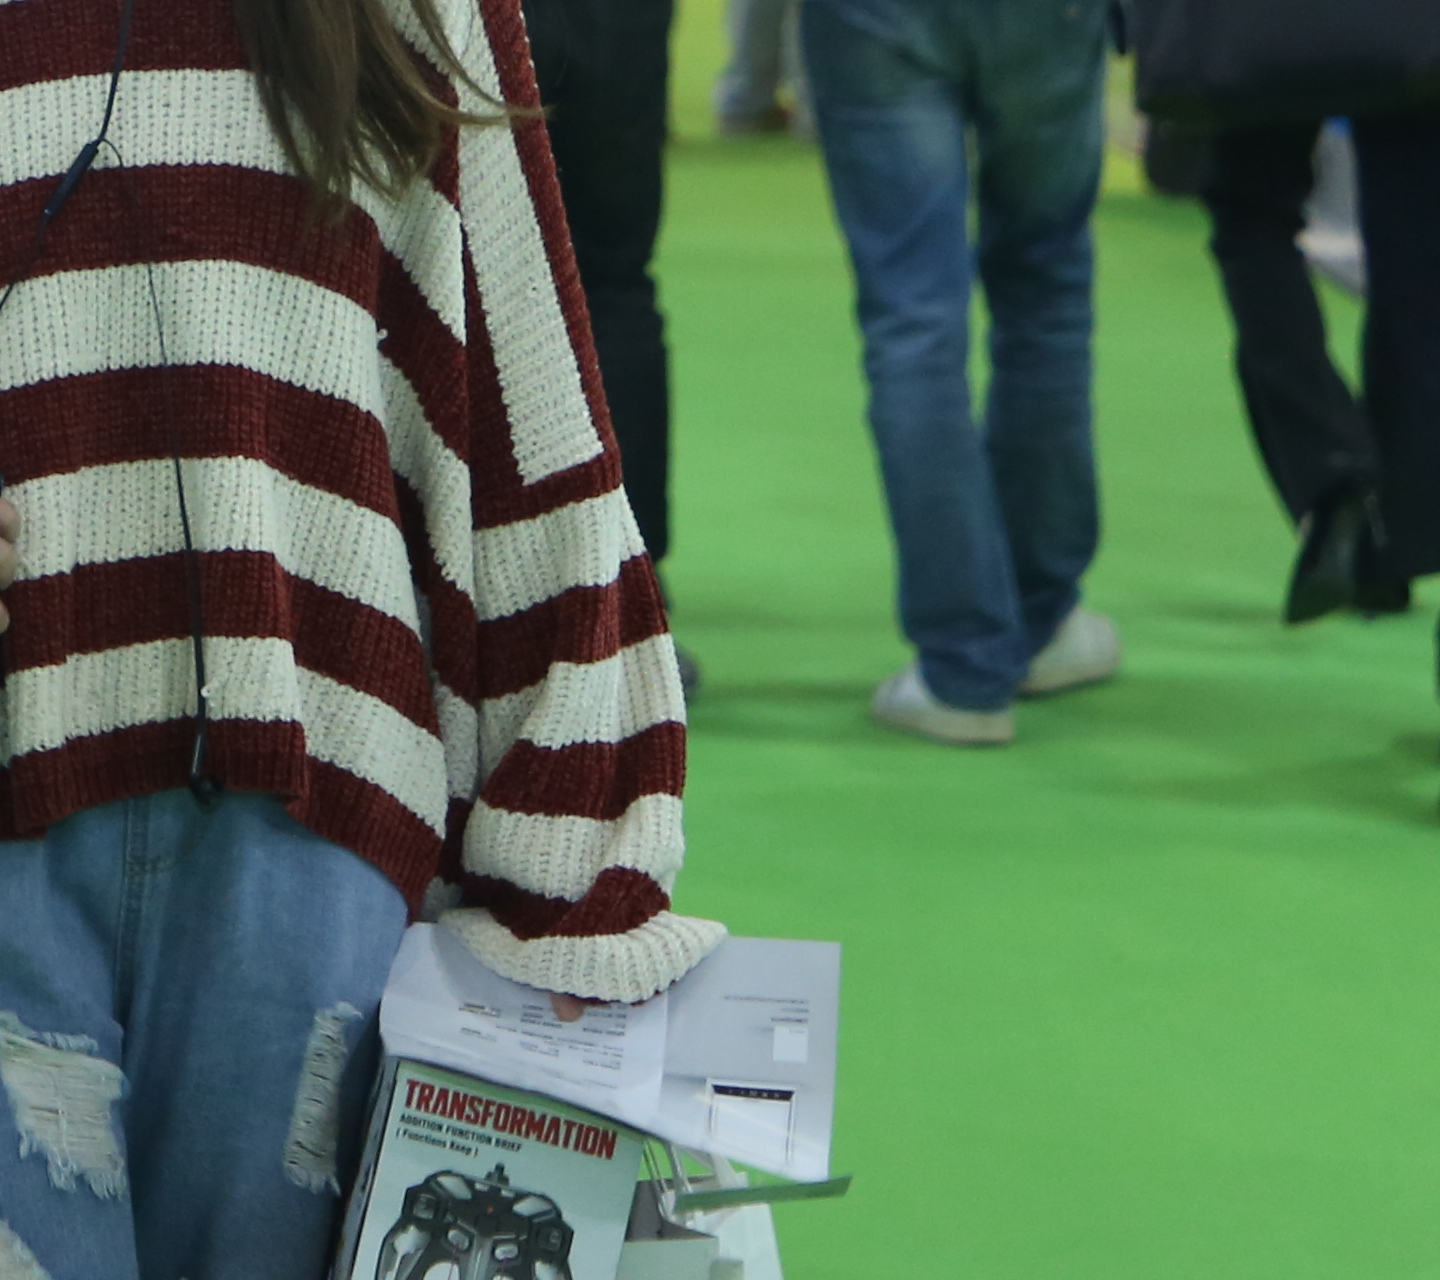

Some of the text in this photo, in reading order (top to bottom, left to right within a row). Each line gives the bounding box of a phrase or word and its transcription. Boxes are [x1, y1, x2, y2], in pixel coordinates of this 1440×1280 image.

[399, 1113, 522, 1153] ADDITION FUNCTION BRIEF
[405, 1079, 618, 1160] TRANSFORMATION
